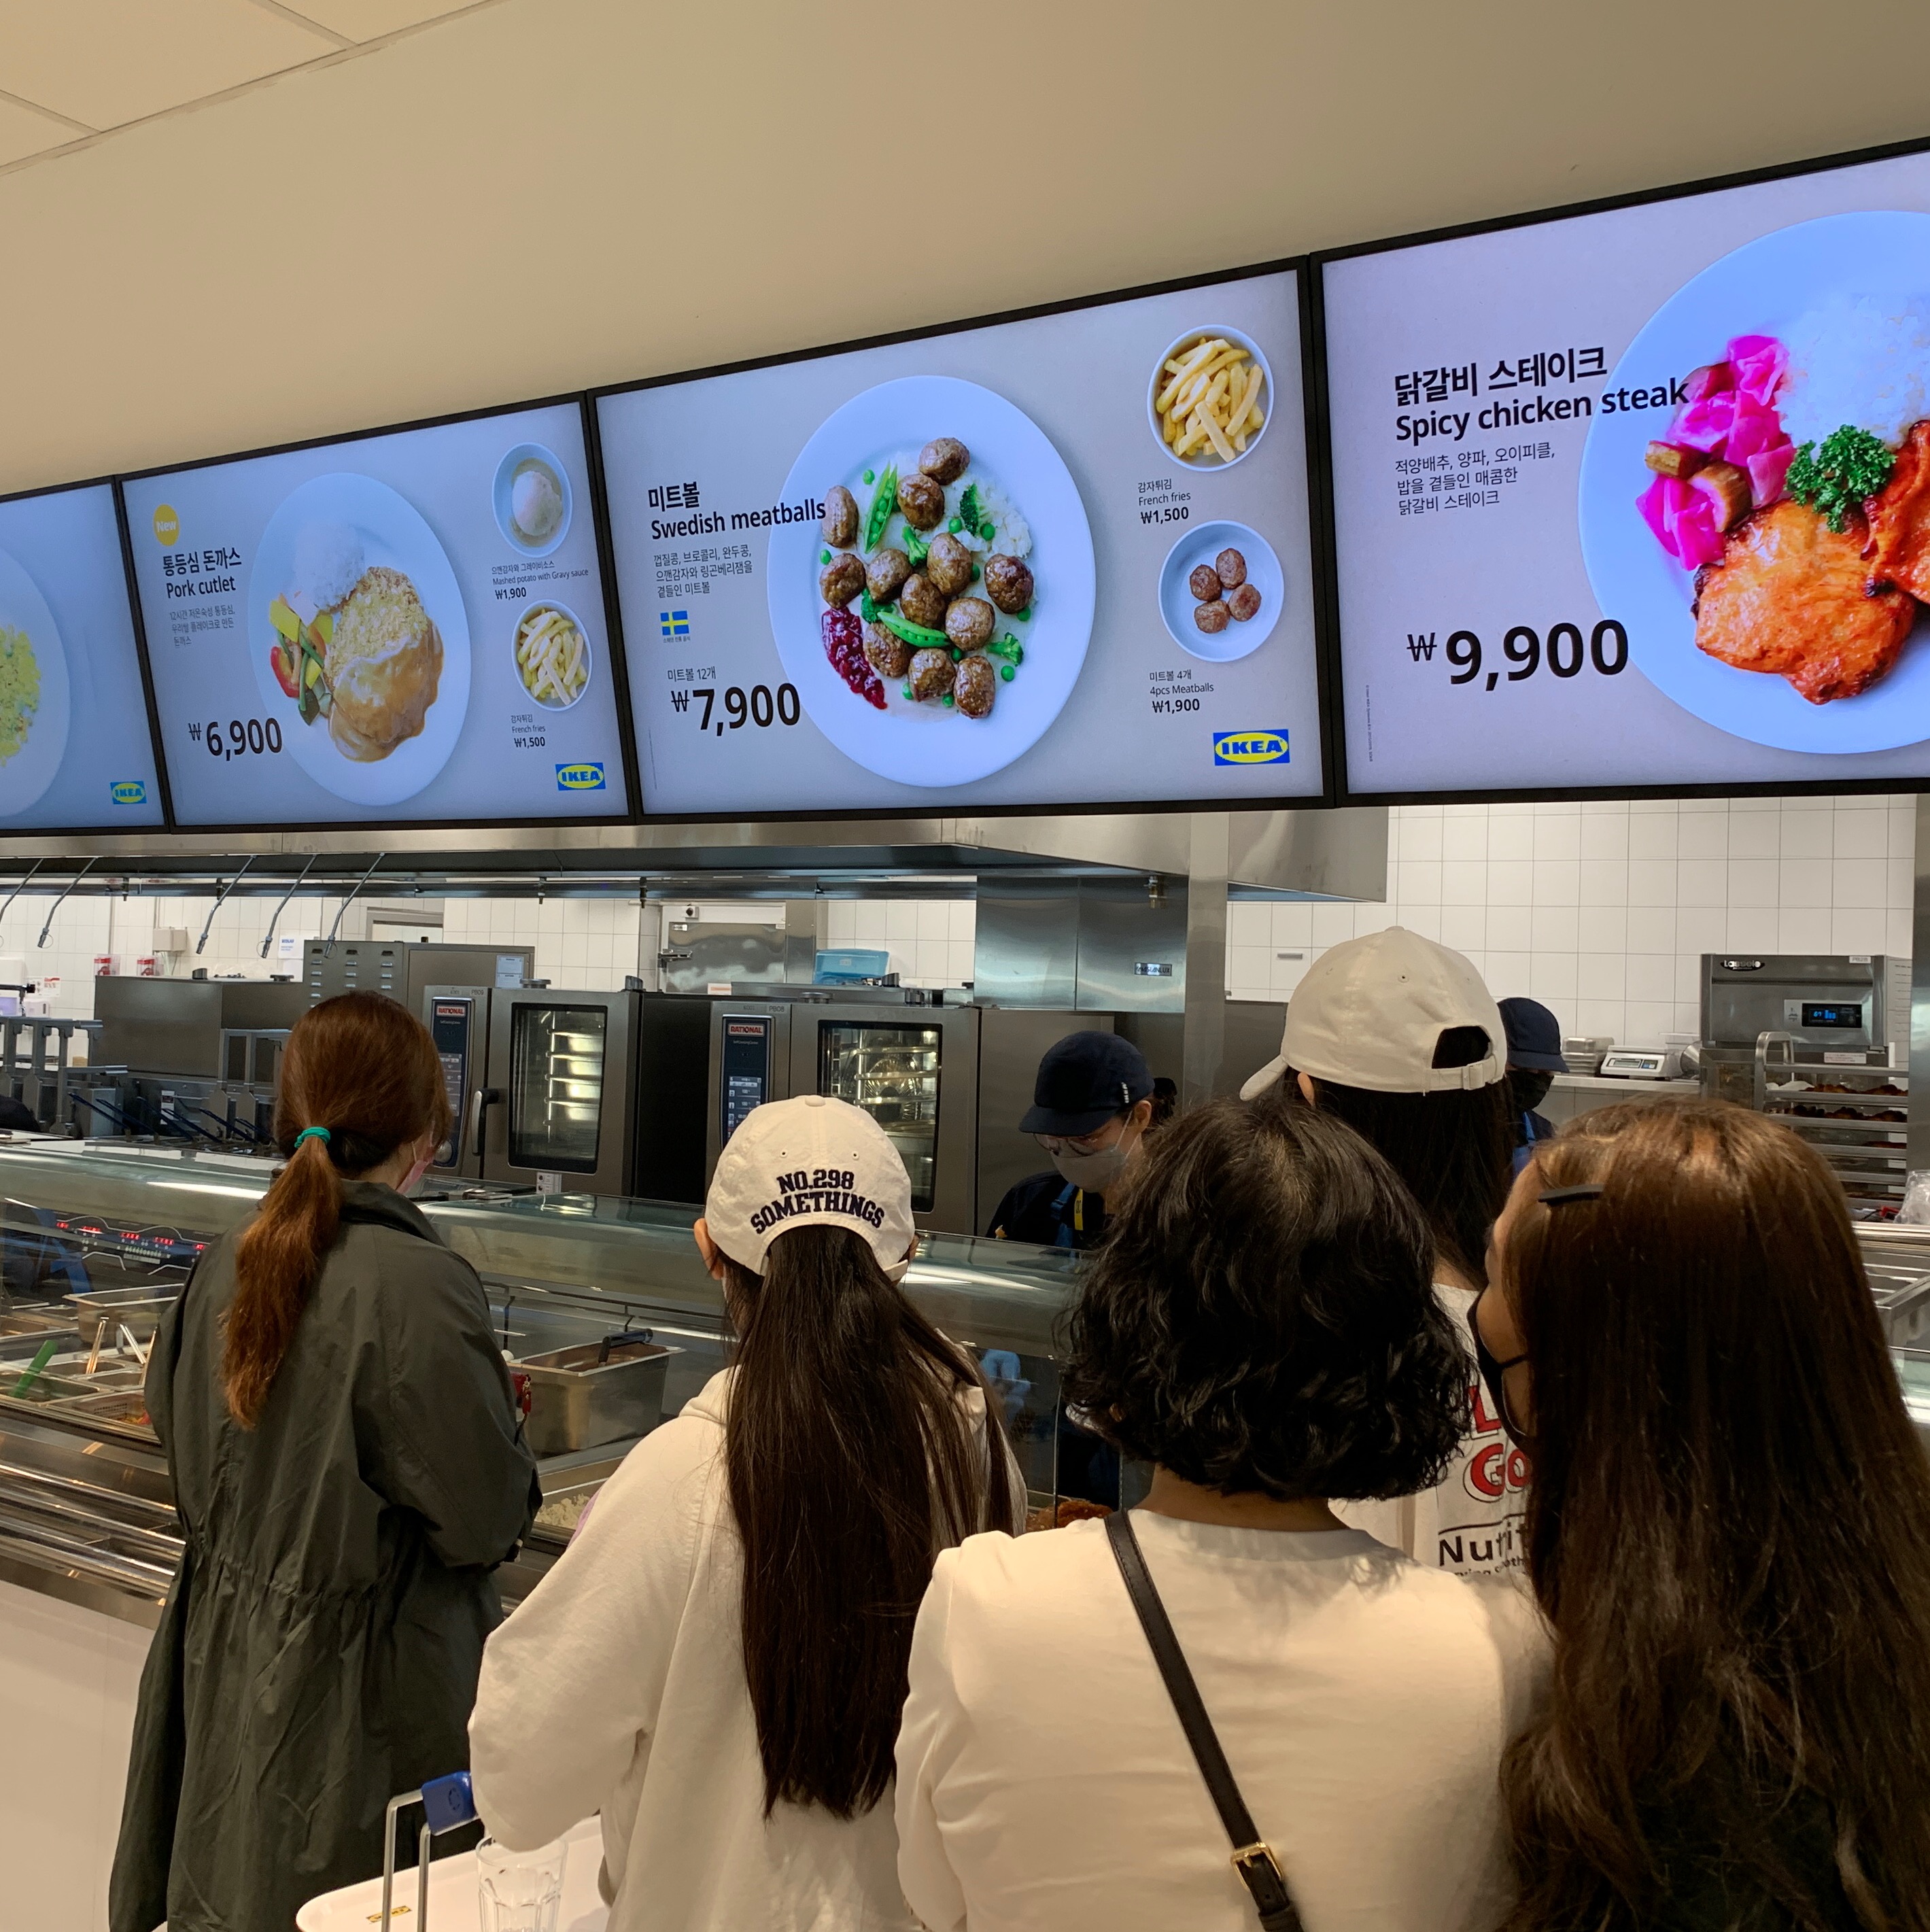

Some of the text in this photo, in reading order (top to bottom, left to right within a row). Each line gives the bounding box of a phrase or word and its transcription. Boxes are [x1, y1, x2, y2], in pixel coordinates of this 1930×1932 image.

[1394, 346, 1608, 407] 닭갈비 스테이크
[1396, 377, 1690, 447] Spicy chicken steak
[1395, 442, 1555, 475] 적양배추, 양파, 오이피클,
[1138, 478, 1172, 494] 감자튀김
[1397, 466, 1518, 495] 밥을 곁들인 매콤한
[648, 481, 700, 512] 미트볼
[1139, 491, 1191, 506] French fries
[1398, 490, 1500, 516] 닭갈비 스테이크
[651, 498, 826, 540] Swedish meatballs
[1140, 506, 1189, 524] ₩1,500
[156, 521, 177, 532] New
[162, 547, 242, 576] 통등심 돈까스
[653, 544, 752, 568] 껍질콩, 브로콜리, 완두콩,
[493, 568, 589, 585] Mashed potato with Gravy sauce
[656, 560, 753, 582] 으깬감자와 링곤베리잼을
[166, 575, 236, 598] Pork cutlet
[495, 587, 527, 600] ₩1,900
[657, 581, 710, 598] 곁들인 미트볼
[667, 666, 717, 683] 미트볼 12개
[1150, 669, 1192, 682] 미트볼 4개
[1150, 683, 1214, 697] 4pcs Meatballs
[671, 683, 801, 737] ₩7,900
[1152, 698, 1200, 714] ₩1,900
[514, 736, 546, 748] ₩1,500
[1222, 740, 1283, 755] IKEA
[562, 771, 600, 782] IKEA
[115, 788, 143, 797] IKEA
[776, 1169, 855, 1194] NO.298
[750, 1191, 884, 1235] SOMETHINGS
